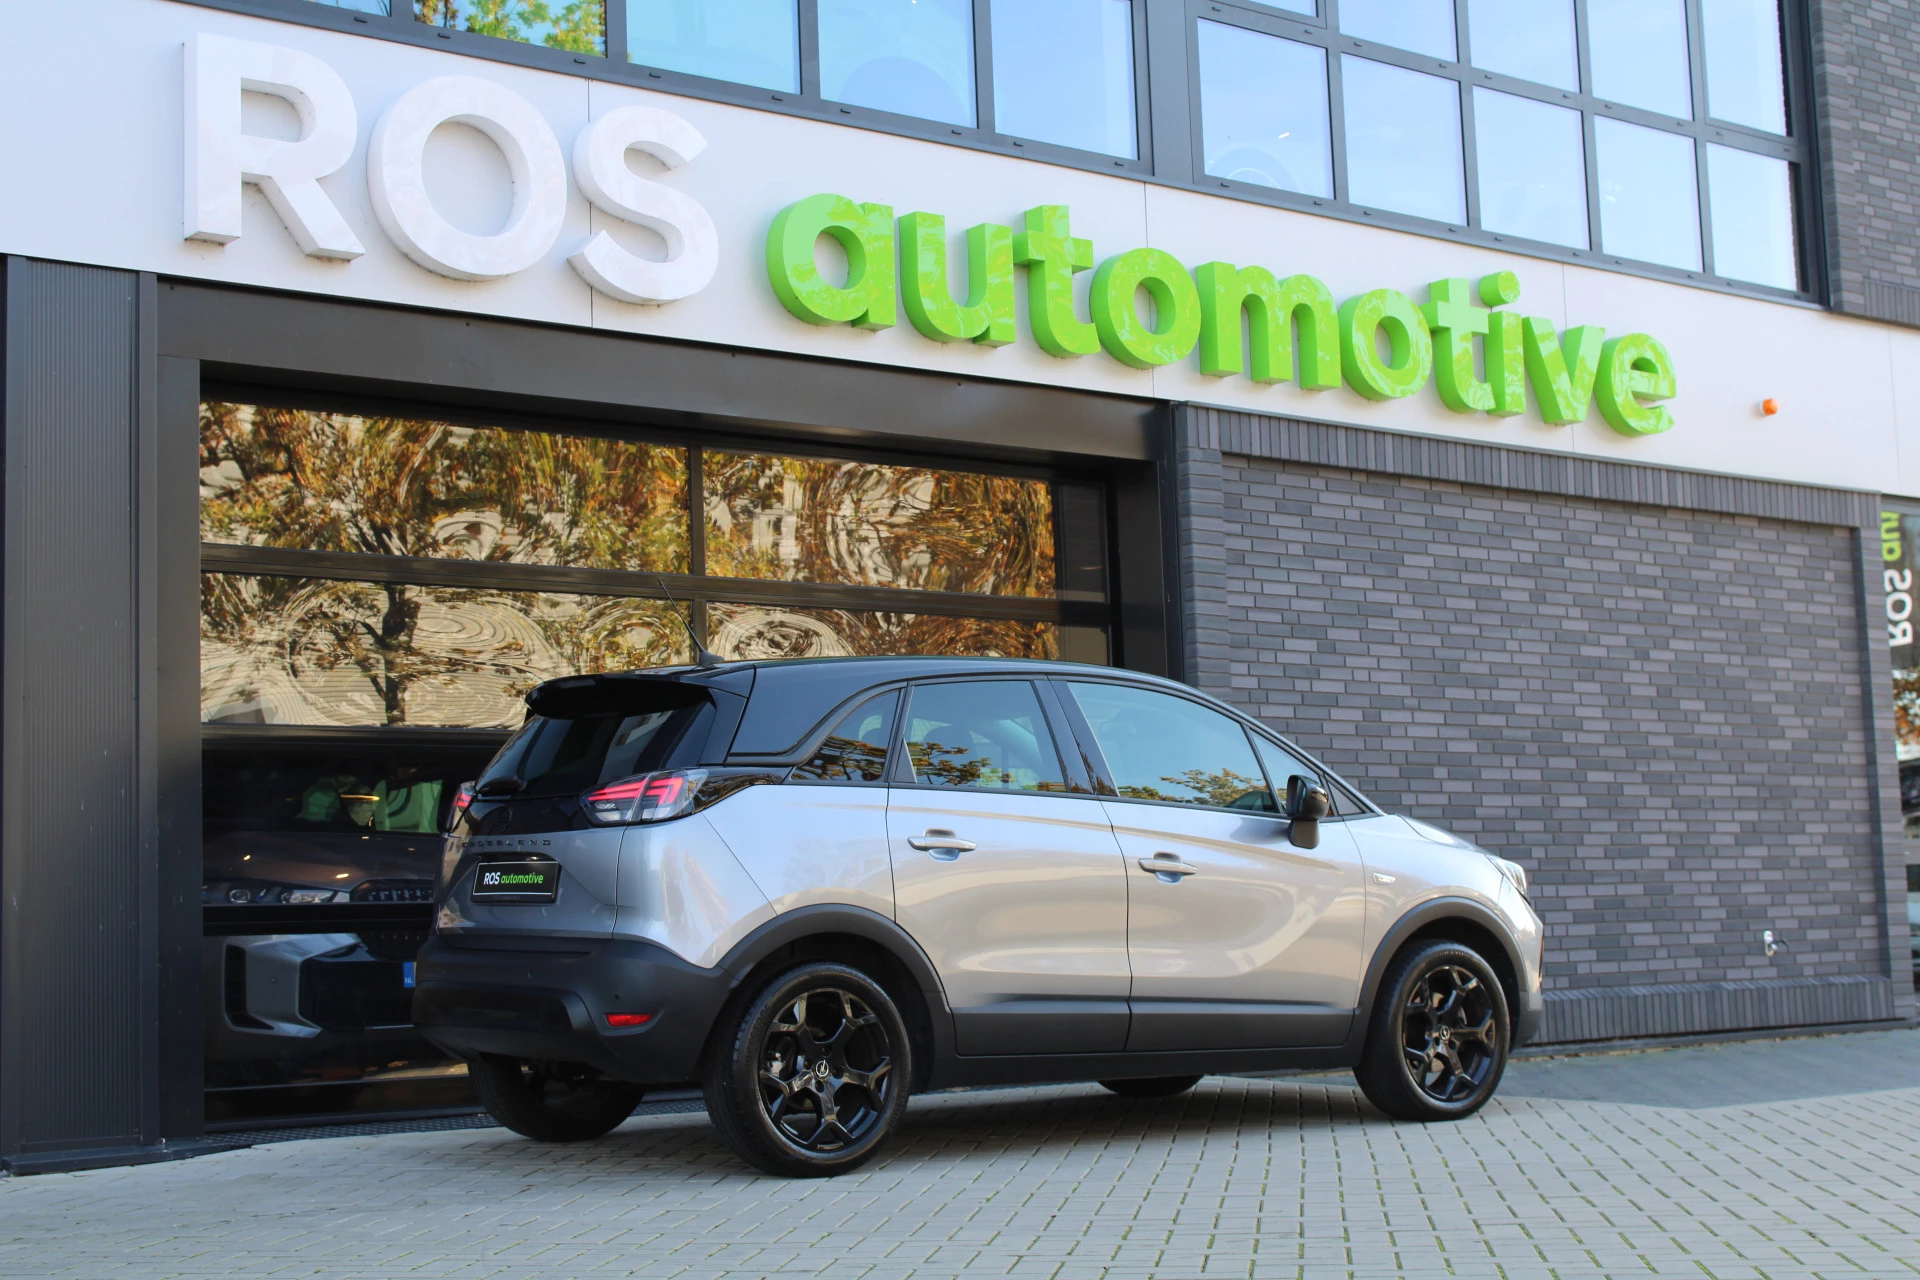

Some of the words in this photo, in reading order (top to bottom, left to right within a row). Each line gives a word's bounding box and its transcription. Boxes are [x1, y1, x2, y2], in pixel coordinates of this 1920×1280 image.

[183, 32, 719, 305] ROS
[766, 192, 1677, 437] automotive
[483, 872, 500, 885] ROS
[500, 872, 544, 884] automotive
